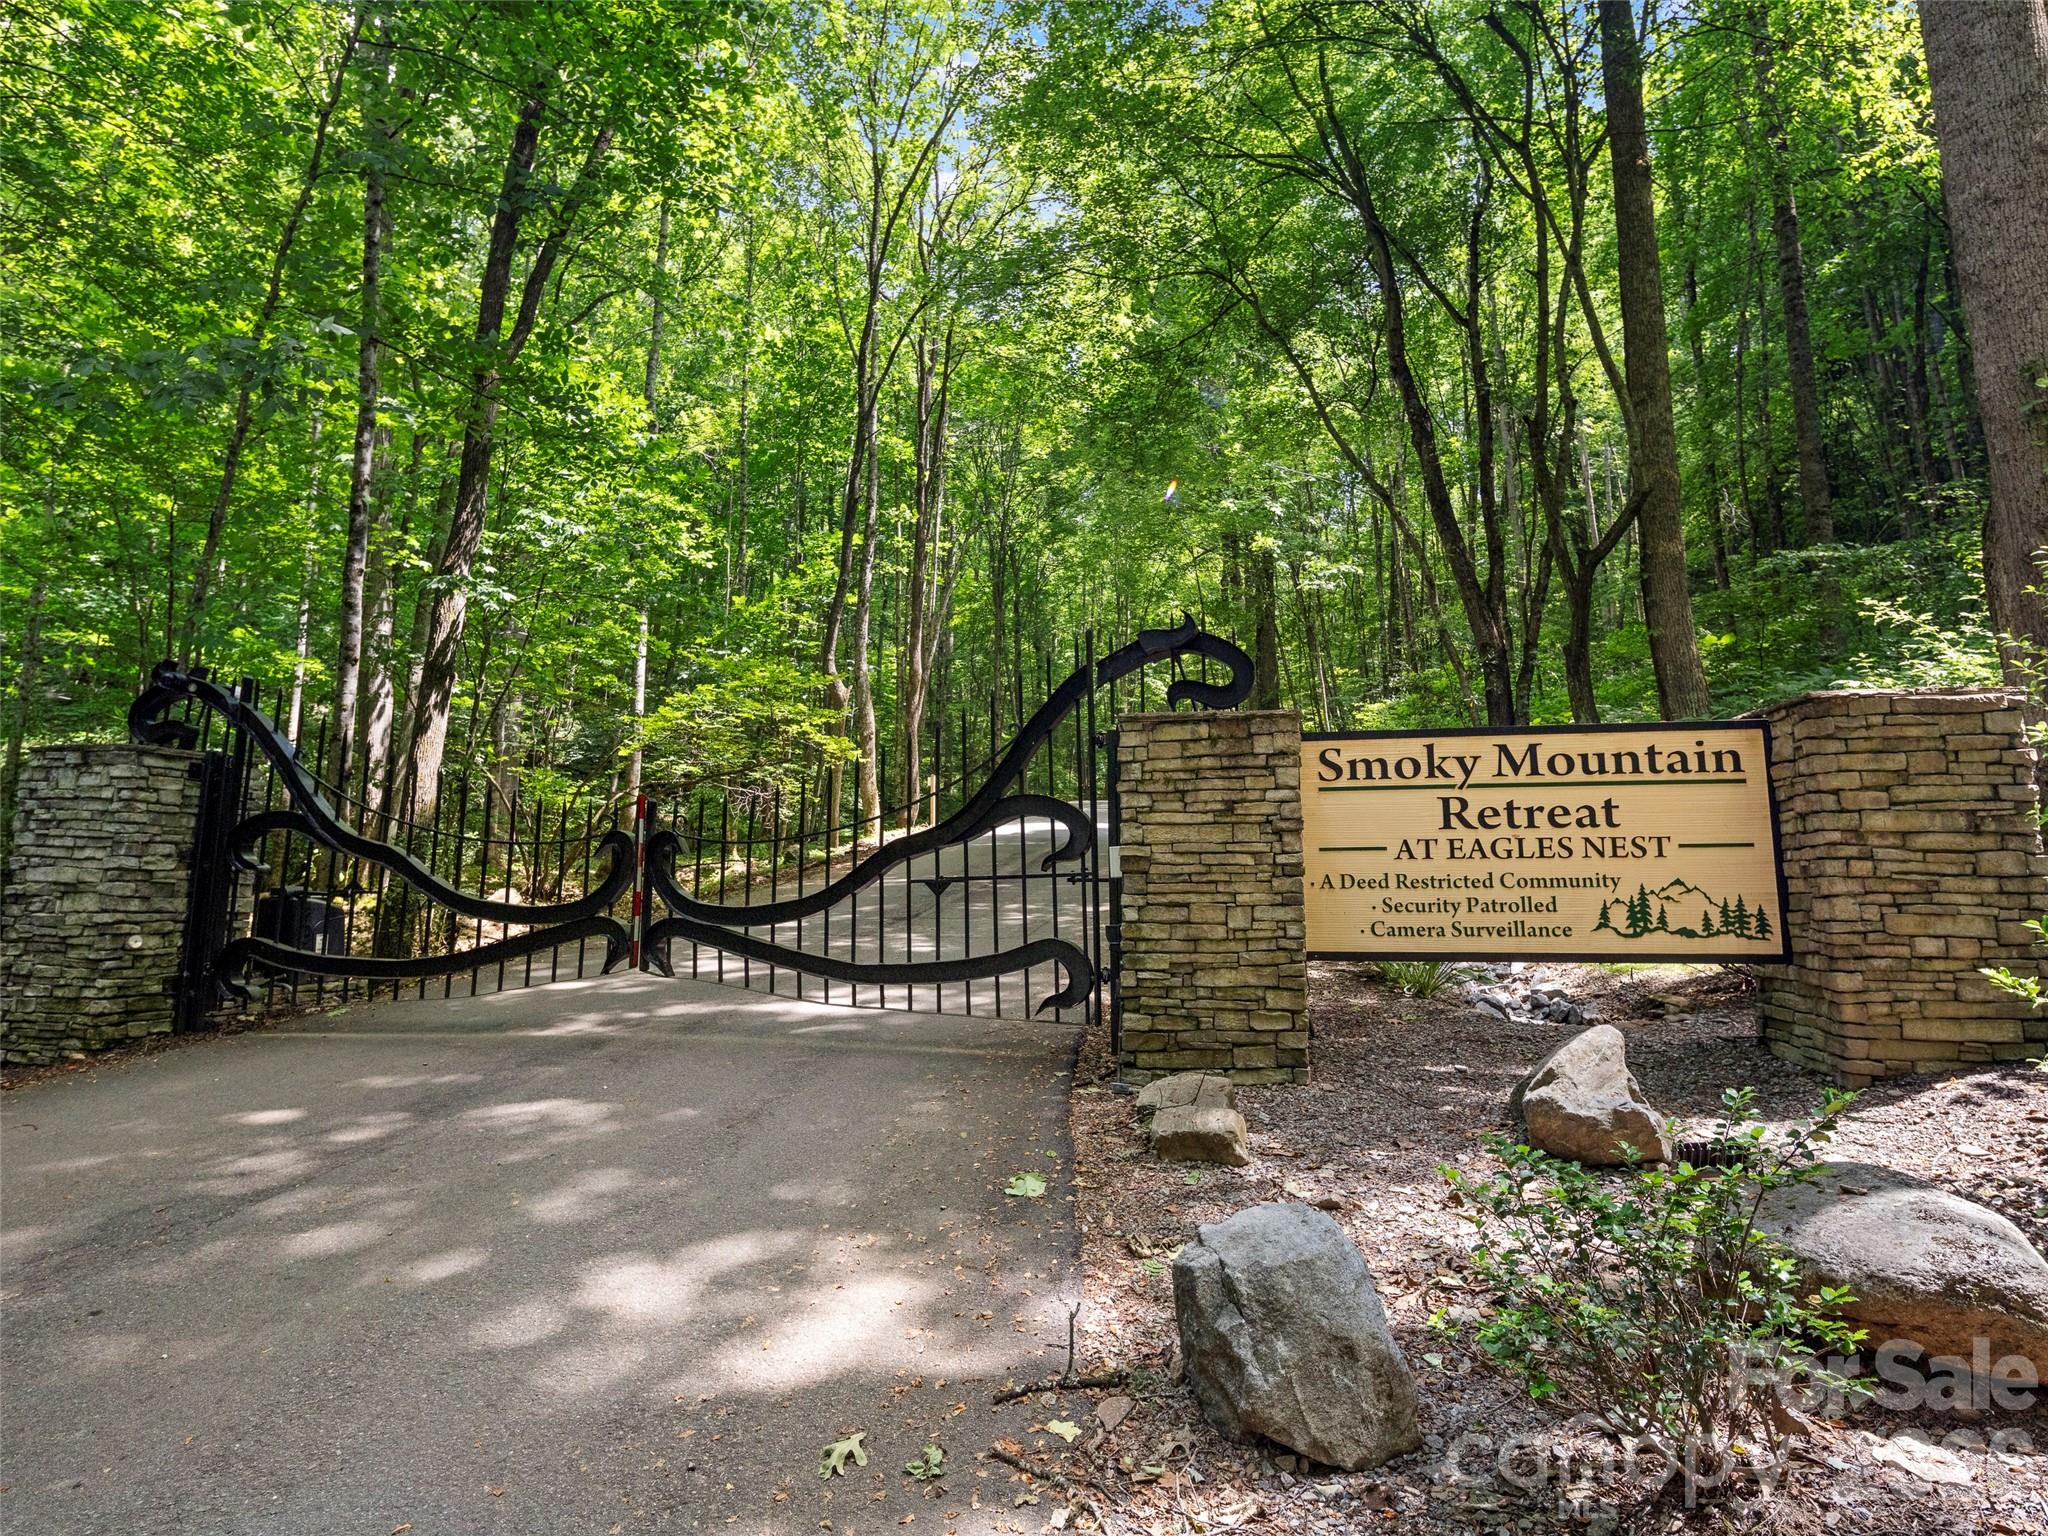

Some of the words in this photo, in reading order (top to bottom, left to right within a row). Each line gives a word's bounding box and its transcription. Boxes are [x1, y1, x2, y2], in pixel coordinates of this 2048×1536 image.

[1317, 743, 1480, 790] Smoky
[1492, 740, 1745, 776] Mountain
[1438, 796, 1621, 830] Retreat
[1394, 838, 1438, 861] AT
[1447, 836, 1574, 860] EAGLES
[1583, 835, 1672, 859] NEST
[1320, 875, 1334, 889] A
[1340, 873, 1390, 890] Deed
[1396, 873, 1494, 890] Restricted
[1500, 873, 1621, 894] Community
[1382, 897, 1461, 917] Security
[1467, 895, 1558, 914] Patrolled
[1371, 922, 1446, 938] Camera
[1451, 920, 1573, 939] Surveillance
